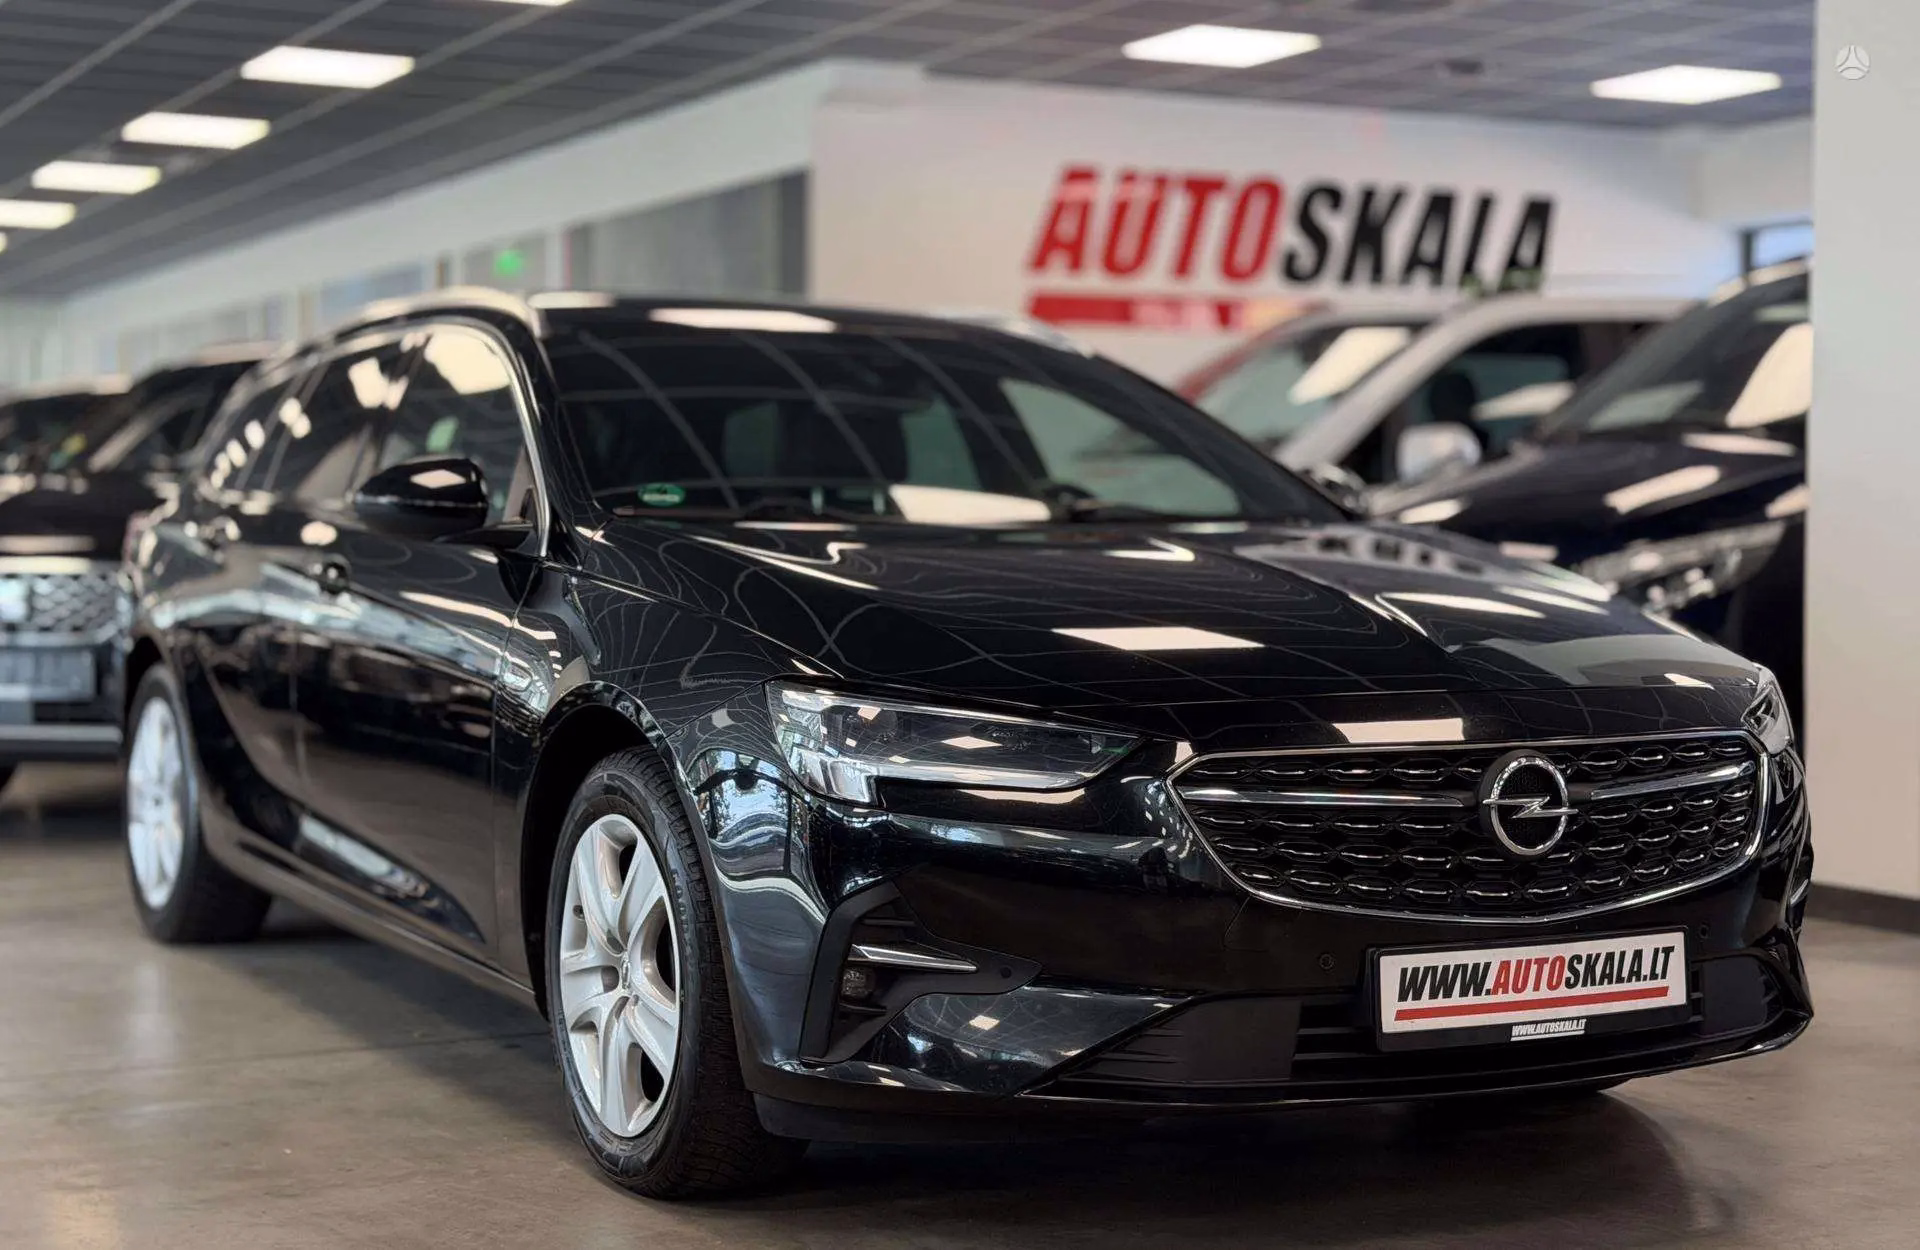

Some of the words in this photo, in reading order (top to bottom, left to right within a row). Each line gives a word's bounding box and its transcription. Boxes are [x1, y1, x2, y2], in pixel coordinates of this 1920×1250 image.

[1029, 164, 1553, 293] AUTOSKALA
[1397, 946, 1674, 1002] WWW.AUTOSKALA.LT
[1511, 1019, 1587, 1036] WWW.AUTOSKALA.LT
